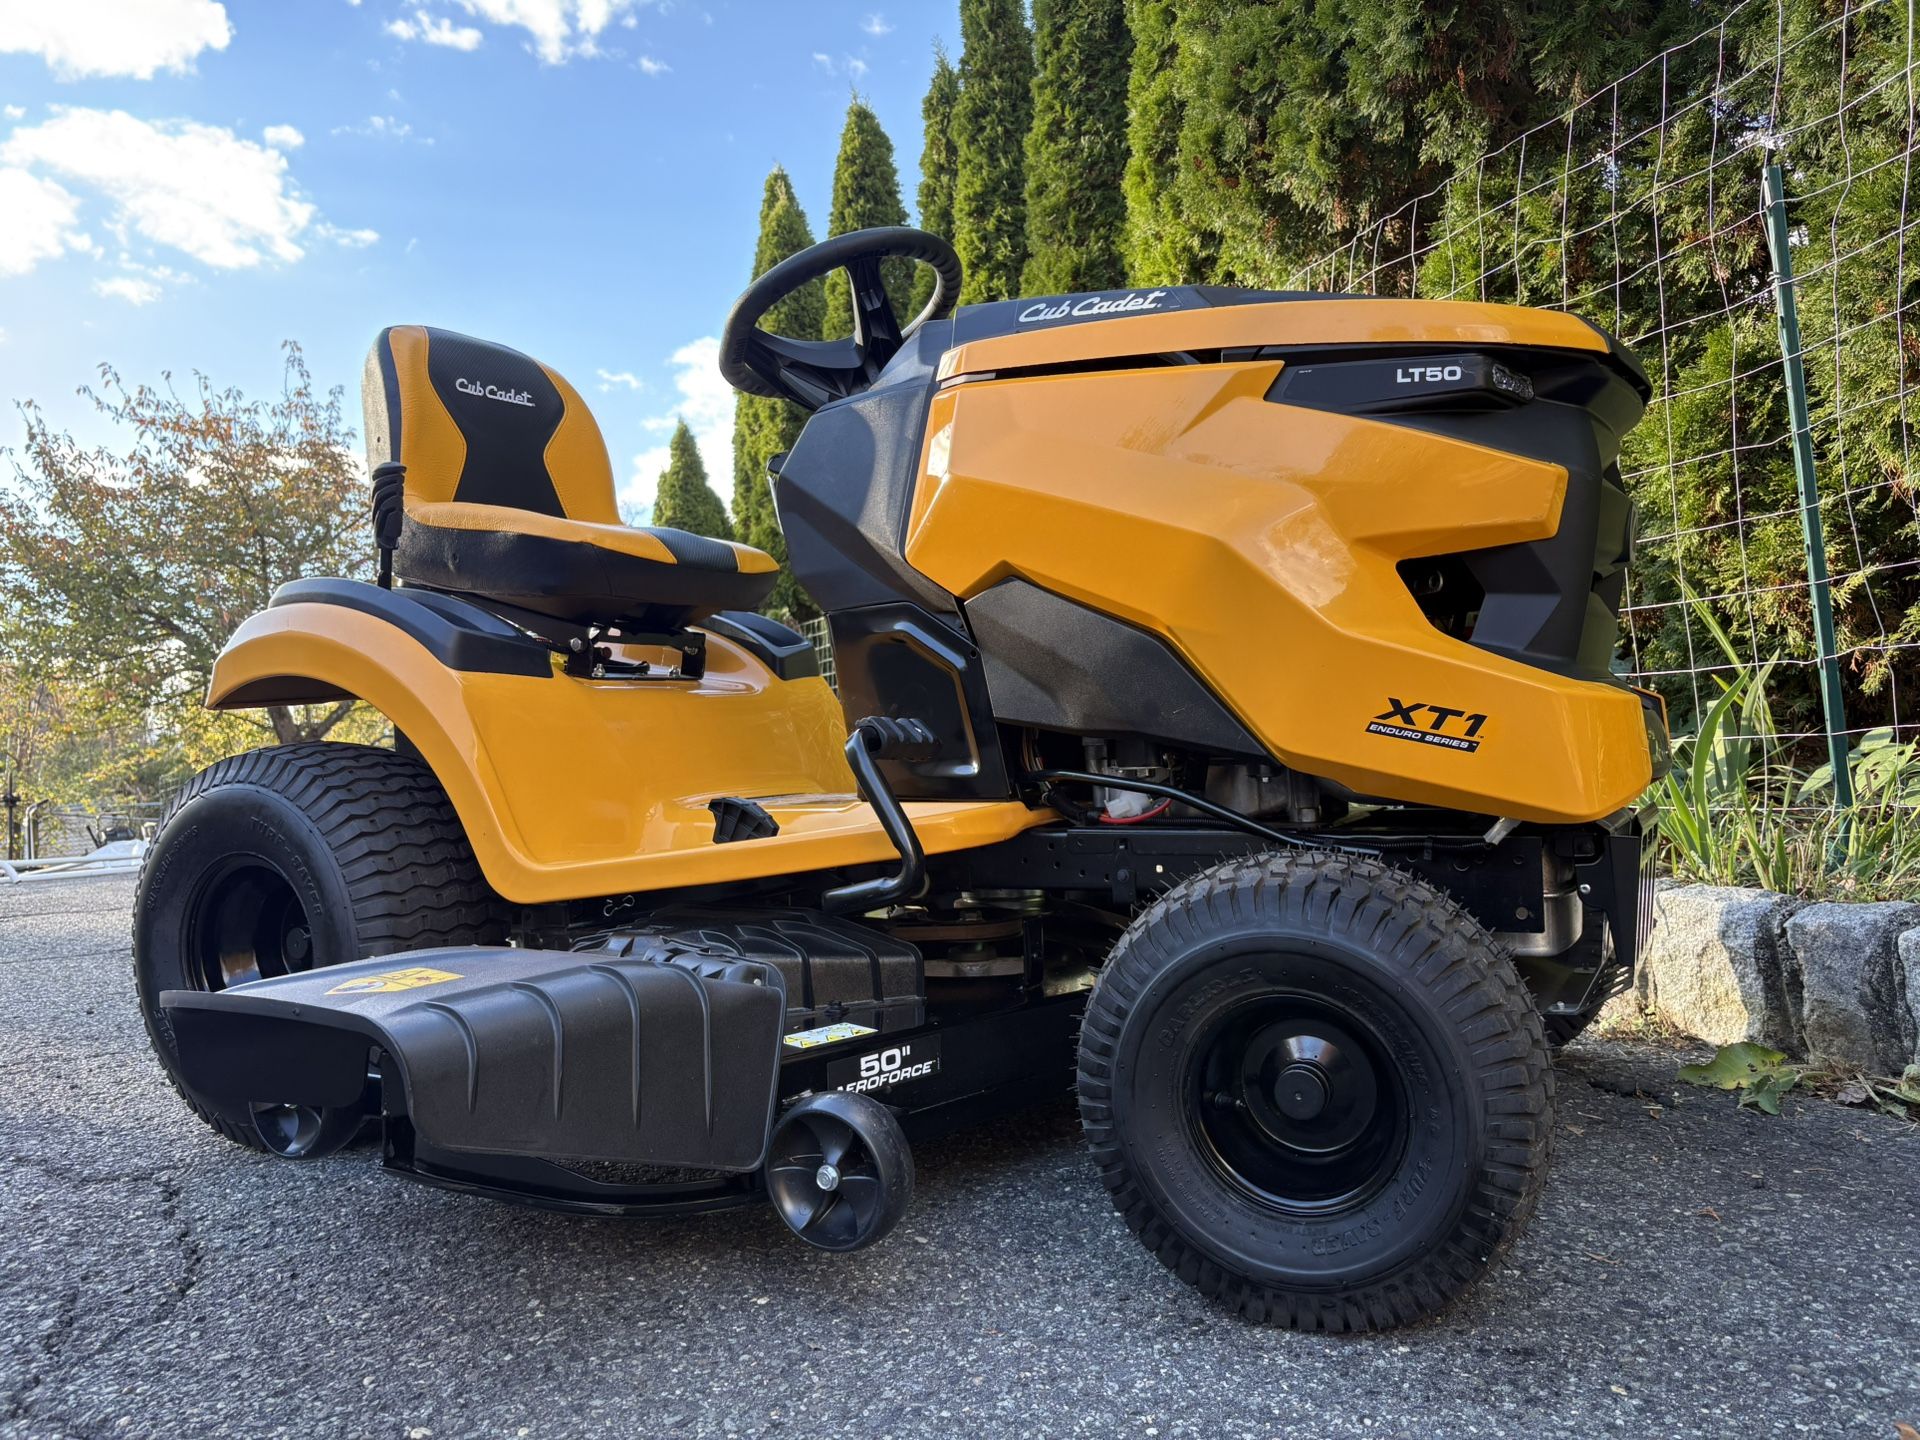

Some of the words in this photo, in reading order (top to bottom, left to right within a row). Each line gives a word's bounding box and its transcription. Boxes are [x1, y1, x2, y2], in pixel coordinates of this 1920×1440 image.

[1018, 300, 1072, 323] Cub
[1071, 290, 1167, 317] Cadet
[1396, 366, 1462, 384] LT50
[455, 378, 484, 397] Cub
[485, 385, 536, 407] Cadet
[1373, 697, 1488, 737] XT1
[1369, 723, 1422, 740] ENDURO
[1424, 734, 1470, 749] SERIES
